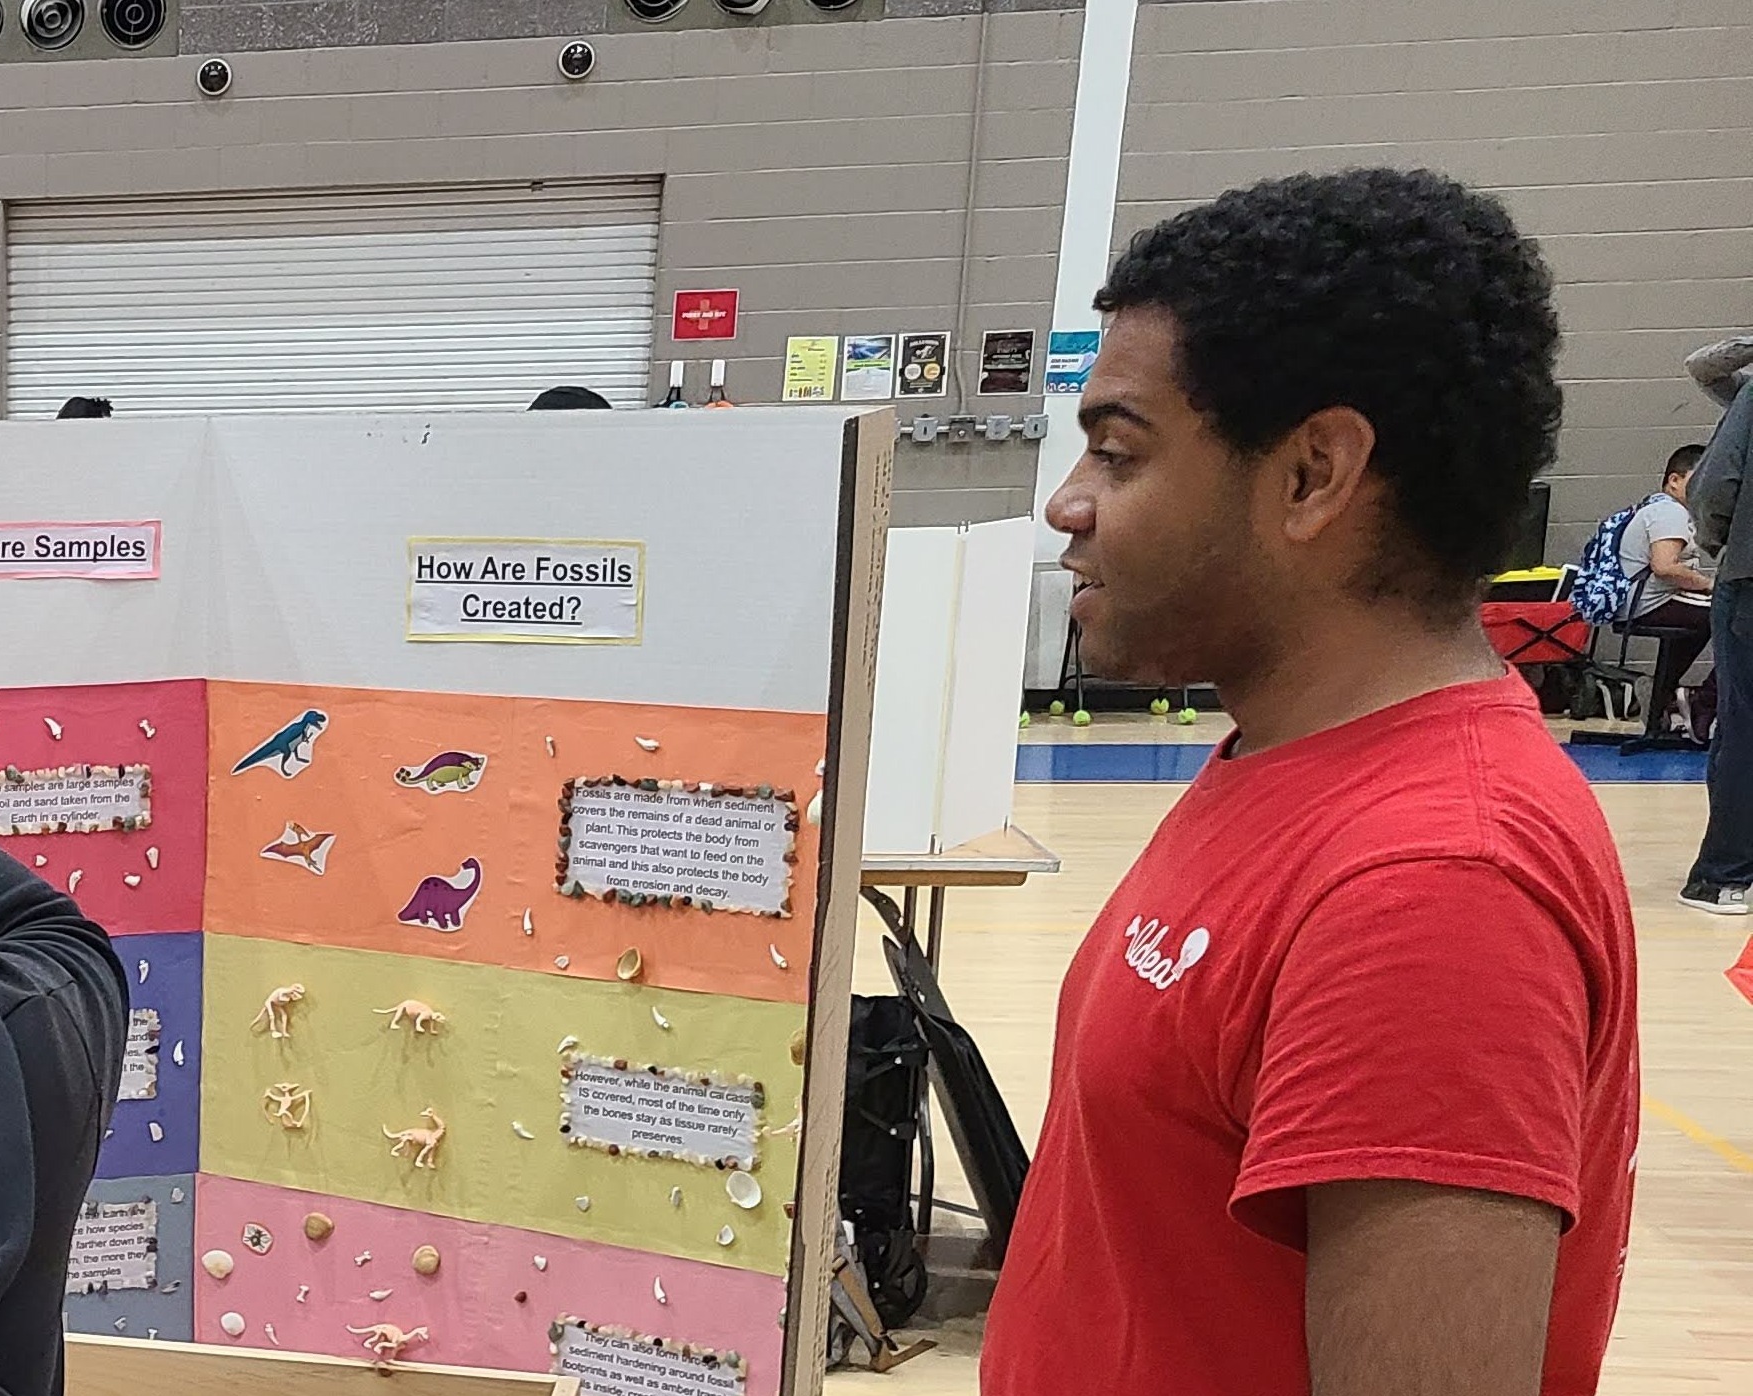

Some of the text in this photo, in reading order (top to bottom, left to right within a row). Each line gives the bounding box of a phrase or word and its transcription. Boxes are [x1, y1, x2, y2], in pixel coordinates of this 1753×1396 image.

[34, 535, 146, 563] Samples
[416, 557, 632, 584] How Are Fossils
[462, 594, 583, 621] Created?
[5, 782, 45, 792] samples
[48, 782, 64, 790] are
[66, 780, 91, 792] large
[93, 778, 134, 789] samples
[12, 798, 31, 807] and
[34, 797, 58, 806] sand
[61, 795, 87, 805] taken
[90, 794, 113, 804] from
[115, 793, 130, 803] the
[576, 787, 774, 813] Fossils are made from when sediment
[11, 810, 101, 824] Earth in a cylinder.
[573, 806, 775, 831] covers the remains of a dead animal or
[586, 823, 759, 847] plant. This protects the body from
[579, 840, 764, 866] scavengers that want to feed on the
[573, 856, 769, 886] animal and this also protects the body
[606, 875, 730, 899] from erosion and decay.
[575, 1071, 707, 1097] However, while the animal
[592, 1091, 745, 1122] covered, most of the time only
[584, 1105, 738, 1137] the bones stay as tissue rarely
[631, 1128, 685, 1145] preserves.
[108, 1223, 144, 1234] species
[109, 1238, 134, 1247] down
[82, 1267, 121, 1278] samples
[584, 1332, 609, 1347] They
[611, 1340, 629, 1350] can
[656, 1347, 679, 1360] form
[569, 1346, 614, 1363] sediment
[616, 1355, 666, 1376] hardening
[669, 1368, 705, 1382] around
[562, 1359, 607, 1377] footprints
[610, 1371, 622, 1380] as
[646, 1379, 659, 1388] as
[661, 1382, 694, 1396] amber
